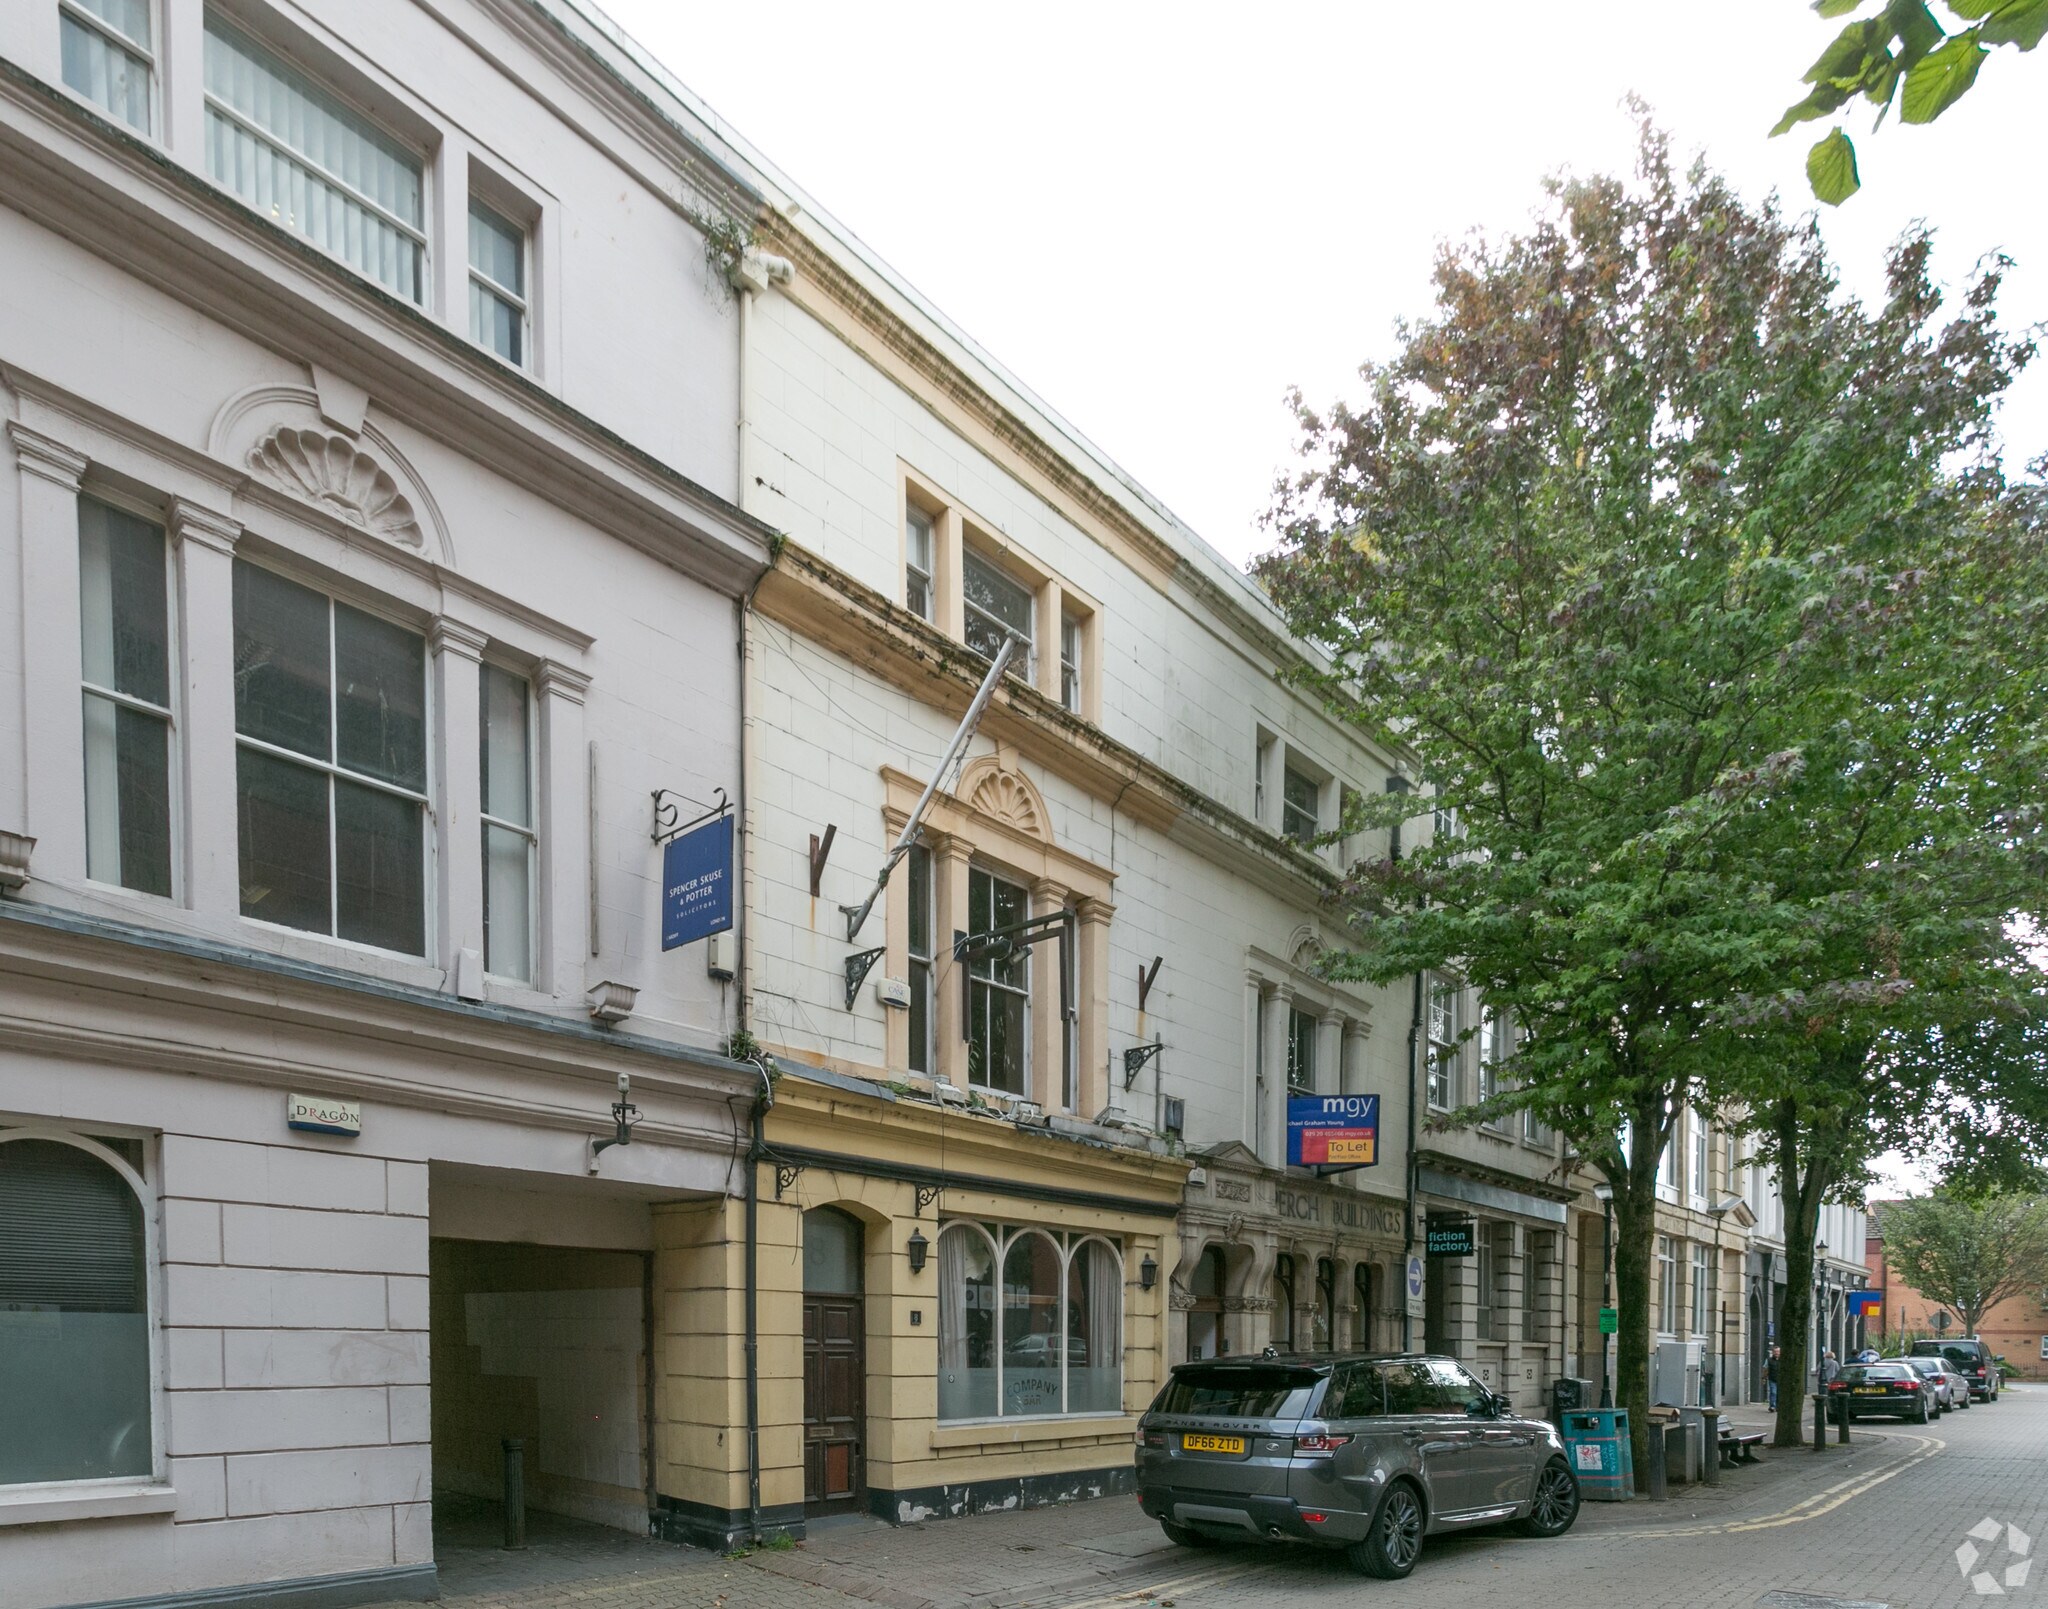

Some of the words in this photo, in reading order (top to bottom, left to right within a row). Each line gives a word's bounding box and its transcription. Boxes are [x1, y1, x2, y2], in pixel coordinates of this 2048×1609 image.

[669, 878, 698, 898] SPENCER
[700, 868, 723, 886] SKUSE
[685, 885, 713, 903] POTTER
[676, 899, 716, 919] SOLICITORS
[296, 1104, 359, 1124] DRAGON
[1322, 1097, 1374, 1118] mgy
[1327, 1120, 1345, 1128] Young
[1329, 1141, 1344, 1152] To
[1347, 1141, 1368, 1152] Let
[1332, 1200, 1401, 1234] BUILDINGS
[1427, 1231, 1466, 1241] fiction
[1427, 1241, 1472, 1252] factory.
[1006, 1378, 1058, 1398] COMPANY
[1166, 1419, 1205, 1427] RANGE
[1213, 1422, 1262, 1430] ROVER
[1187, 1435, 1215, 1449] DF66
[1217, 1437, 1240, 1451] ZTD
